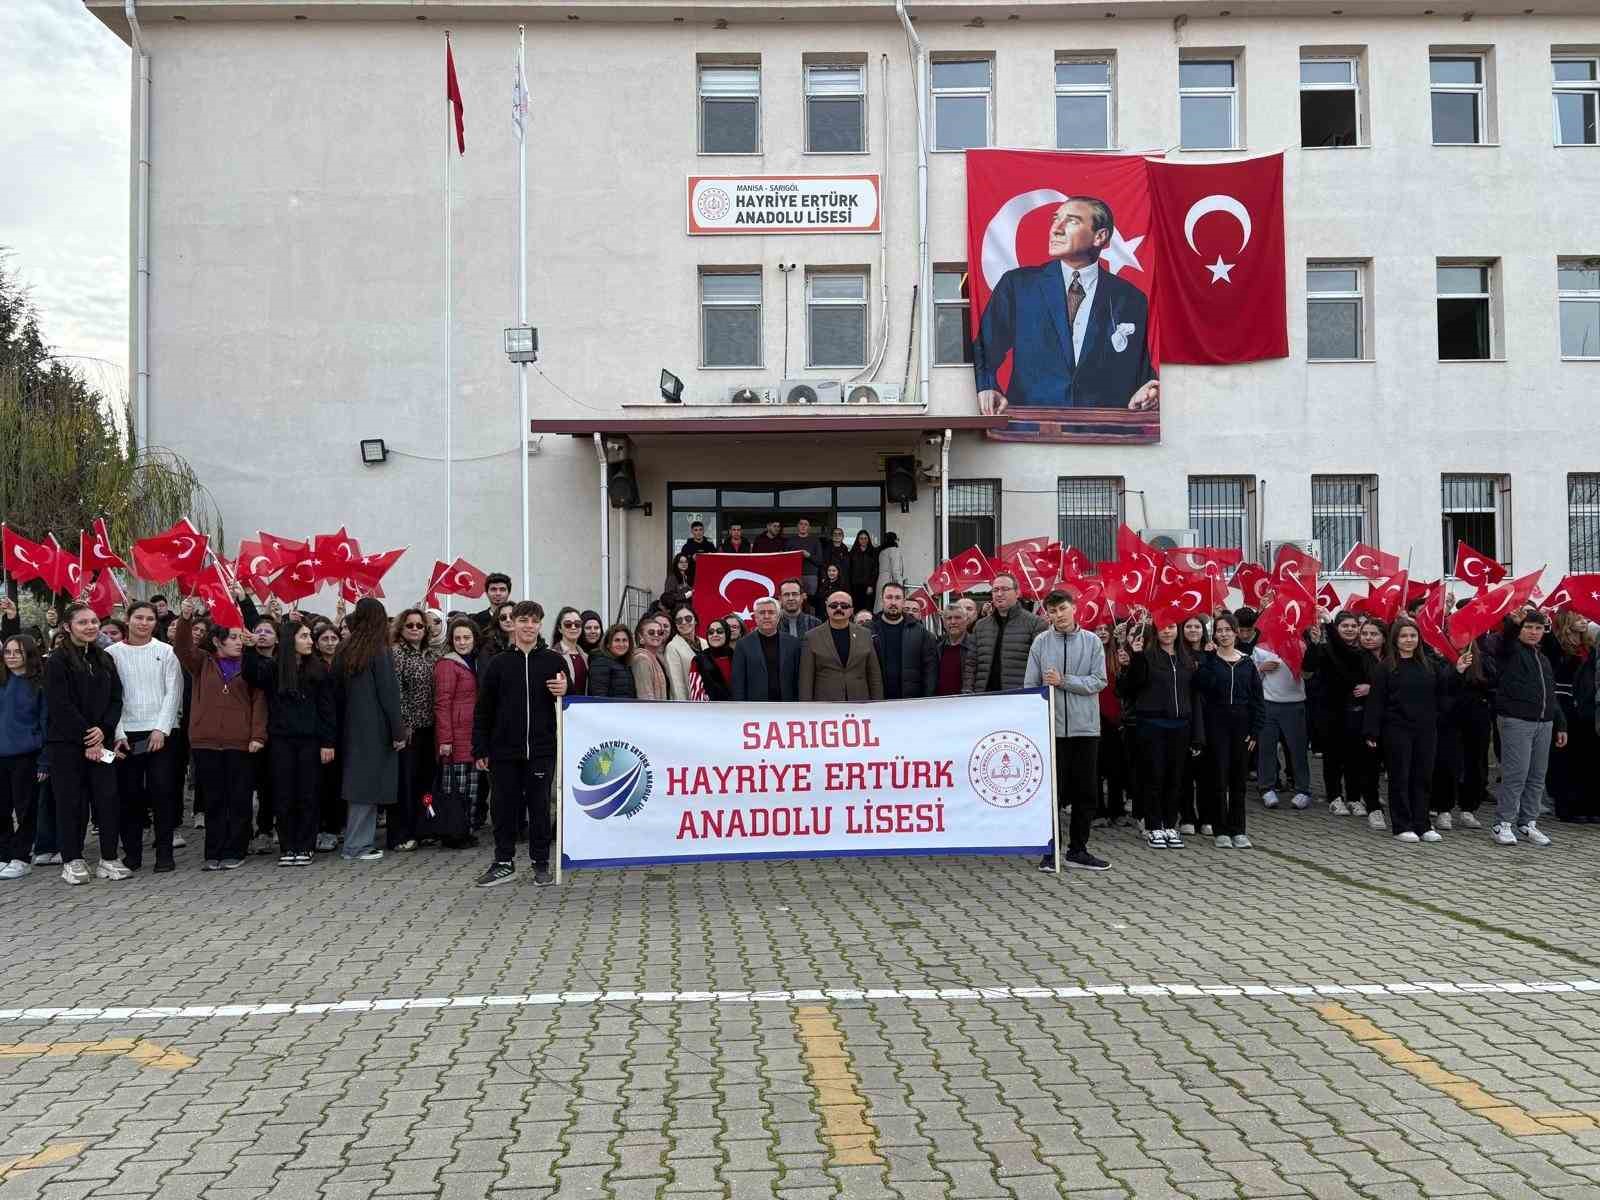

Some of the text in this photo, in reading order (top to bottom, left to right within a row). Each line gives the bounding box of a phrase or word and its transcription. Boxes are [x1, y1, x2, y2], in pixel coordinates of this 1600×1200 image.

[735, 207, 852, 224] ANADOLU LİSESİ
[736, 191, 797, 208] HAYRİYE
[801, 191, 859, 208] ERTÜRK
[742, 713, 880, 750] SARIGÖL
[666, 758, 812, 796] HAYRİYE
[824, 755, 954, 791] ERTÜRK
[676, 797, 946, 839] ANADOLU LİSESİ
